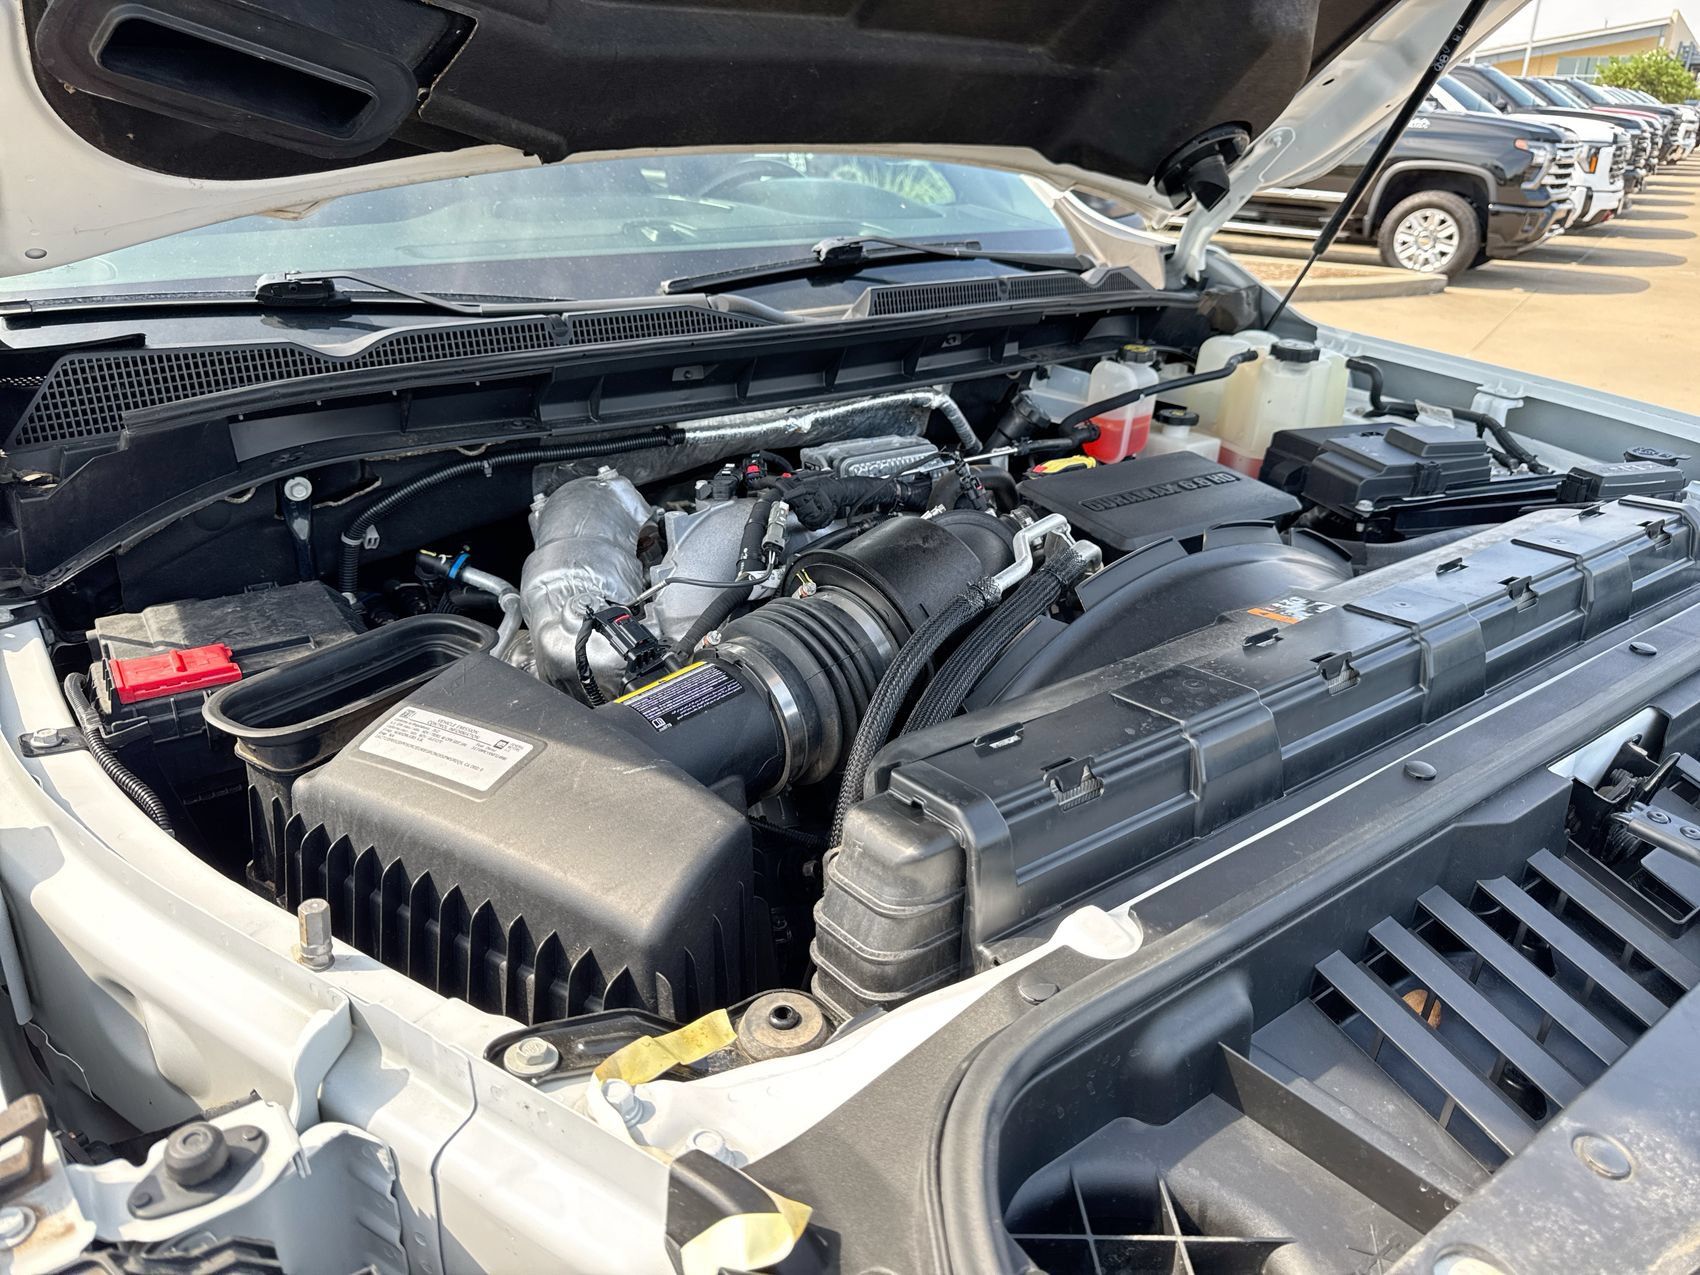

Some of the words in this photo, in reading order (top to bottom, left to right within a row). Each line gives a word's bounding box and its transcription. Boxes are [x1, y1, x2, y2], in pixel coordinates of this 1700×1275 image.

[1084, 483, 1179, 511] DURAMAX
[1178, 477, 1210, 490] 6.6
[1206, 472, 1236, 485] HD
